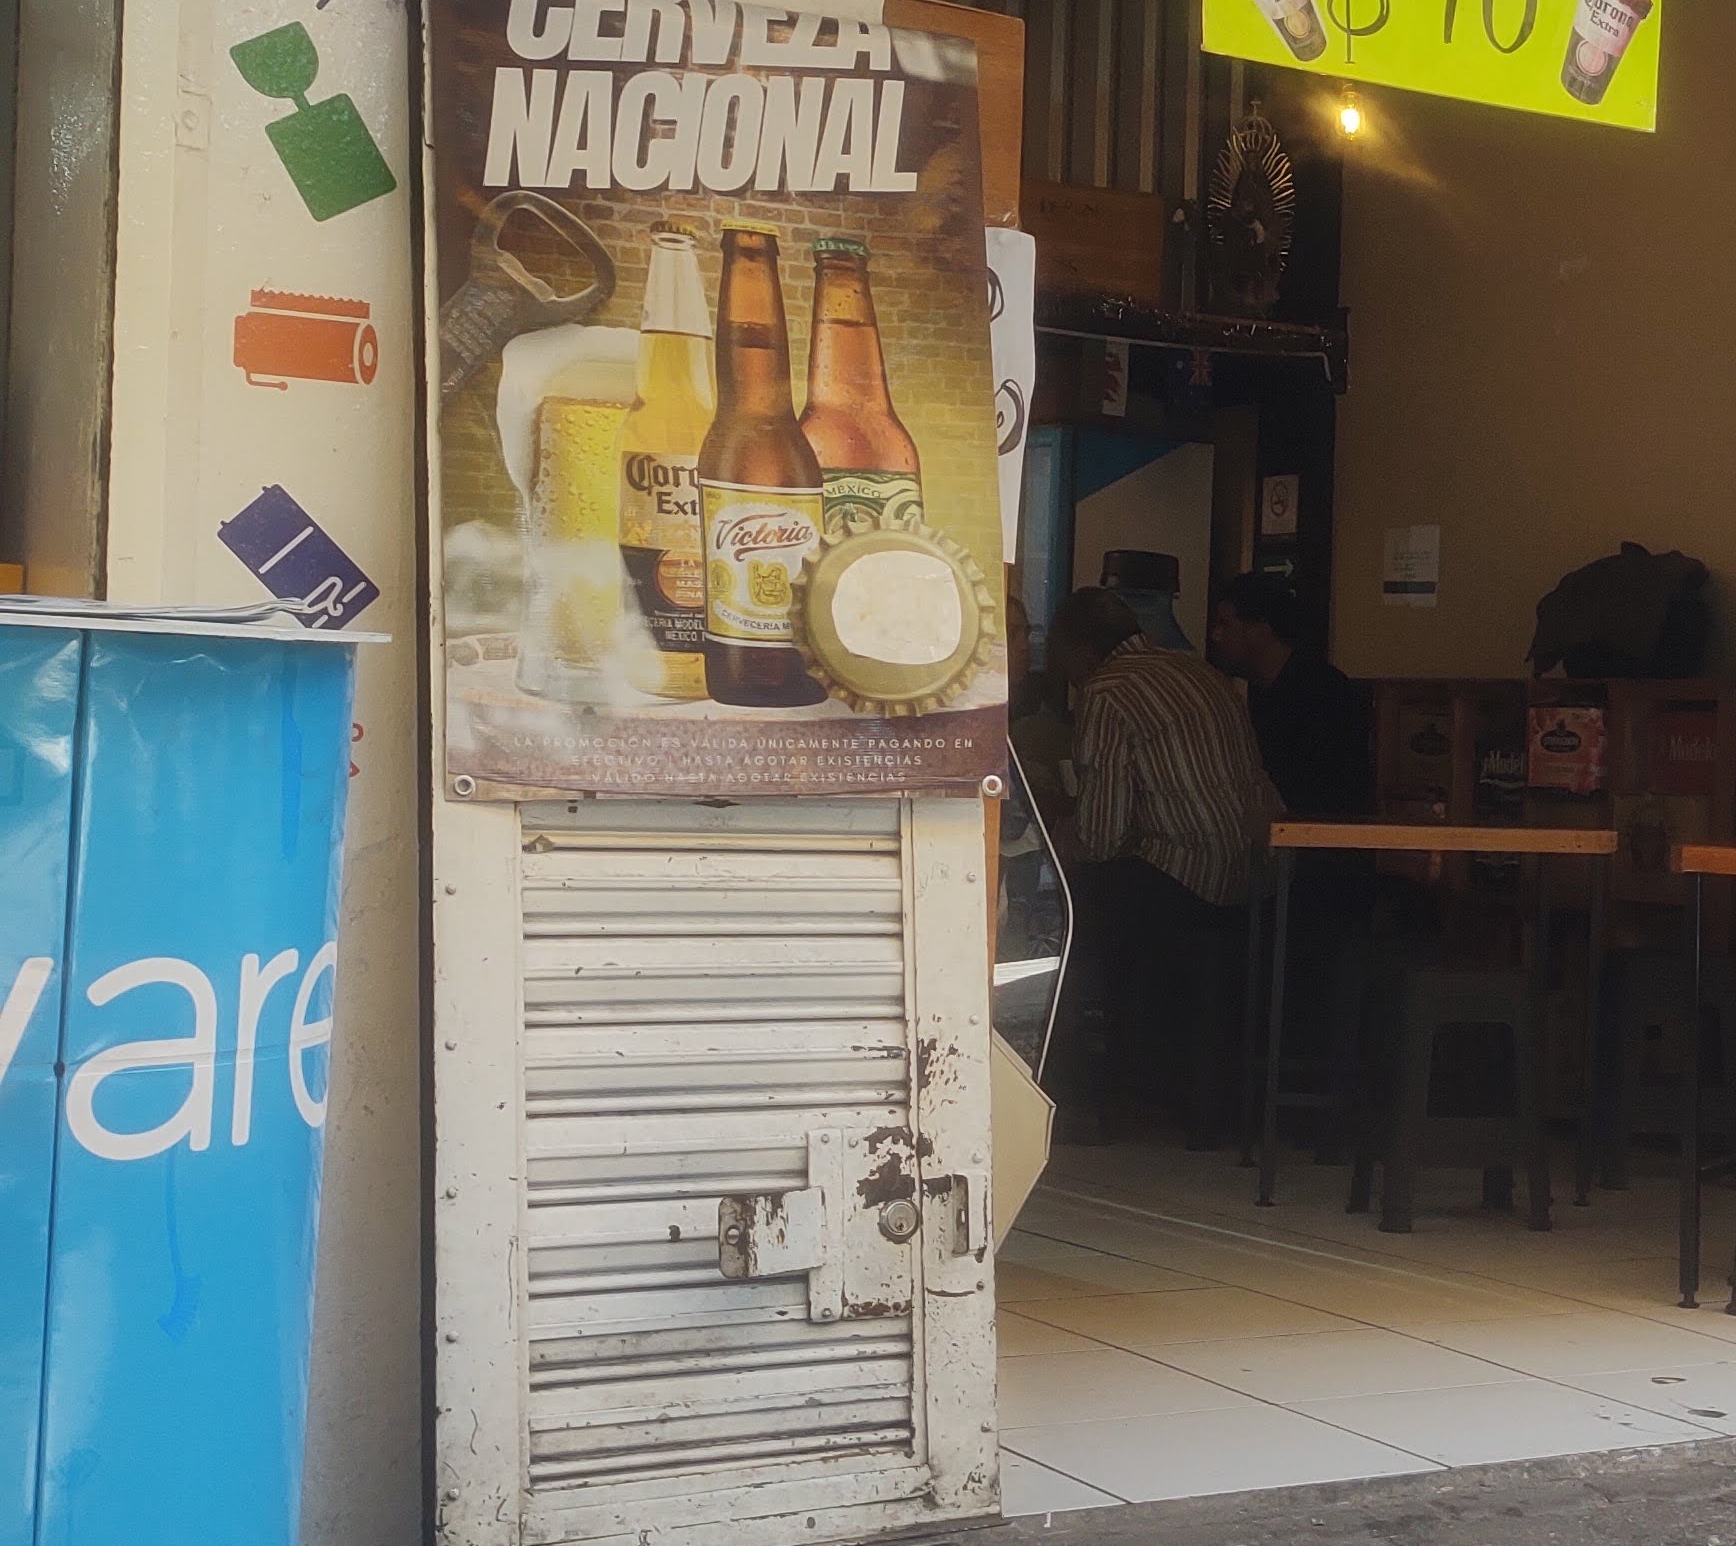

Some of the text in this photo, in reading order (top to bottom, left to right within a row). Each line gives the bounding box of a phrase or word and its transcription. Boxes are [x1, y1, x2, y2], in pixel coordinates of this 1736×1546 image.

[482, 66, 918, 192] NACIONAL
[716, 514, 813, 555] Victoria
[868, 738, 946, 749] PAGANDO
